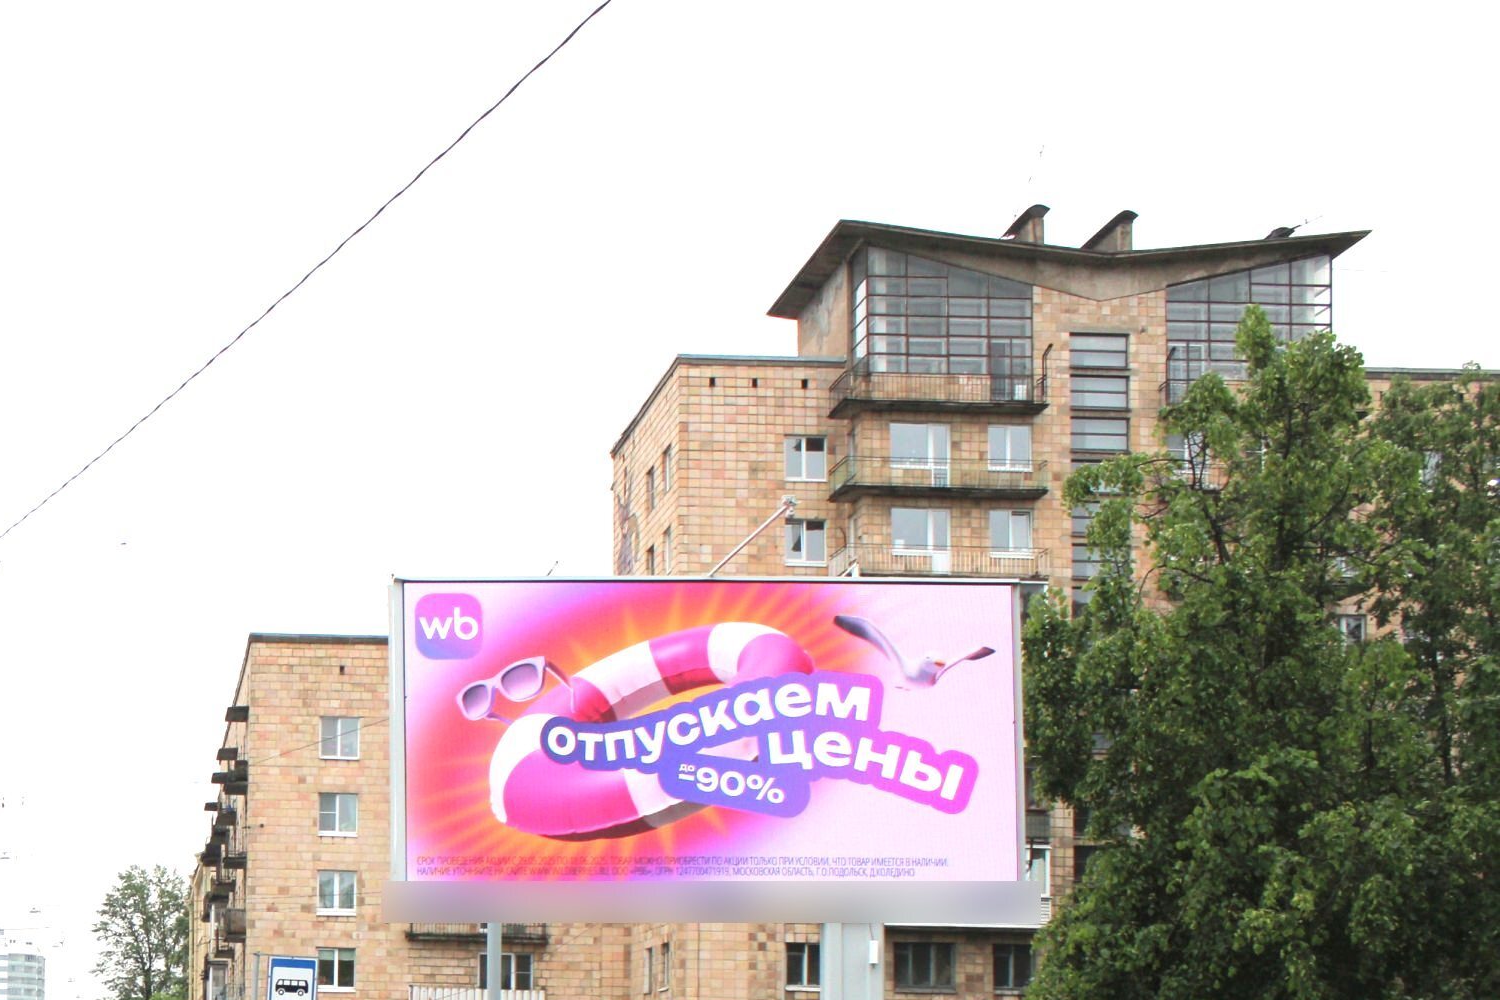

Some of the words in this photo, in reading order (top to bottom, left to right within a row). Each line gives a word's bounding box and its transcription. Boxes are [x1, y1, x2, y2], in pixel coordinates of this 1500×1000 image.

[419, 606, 478, 641] wb
[547, 683, 870, 764] отпускаем
[679, 763, 695, 773] до
[768, 730, 964, 801] цены
[724, 857, 748, 867] АКЦИИ
[749, 857, 777, 867] ТОЛЬКО
[779, 857, 794, 867] ПРИ
[832, 857, 847, 867] ЧТО
[848, 857, 870, 868] ТОВАР
[871, 857, 904, 868] ИМЕЕТСЯ
[732, 867, 780, 877] МОСКОВСКАЯ
